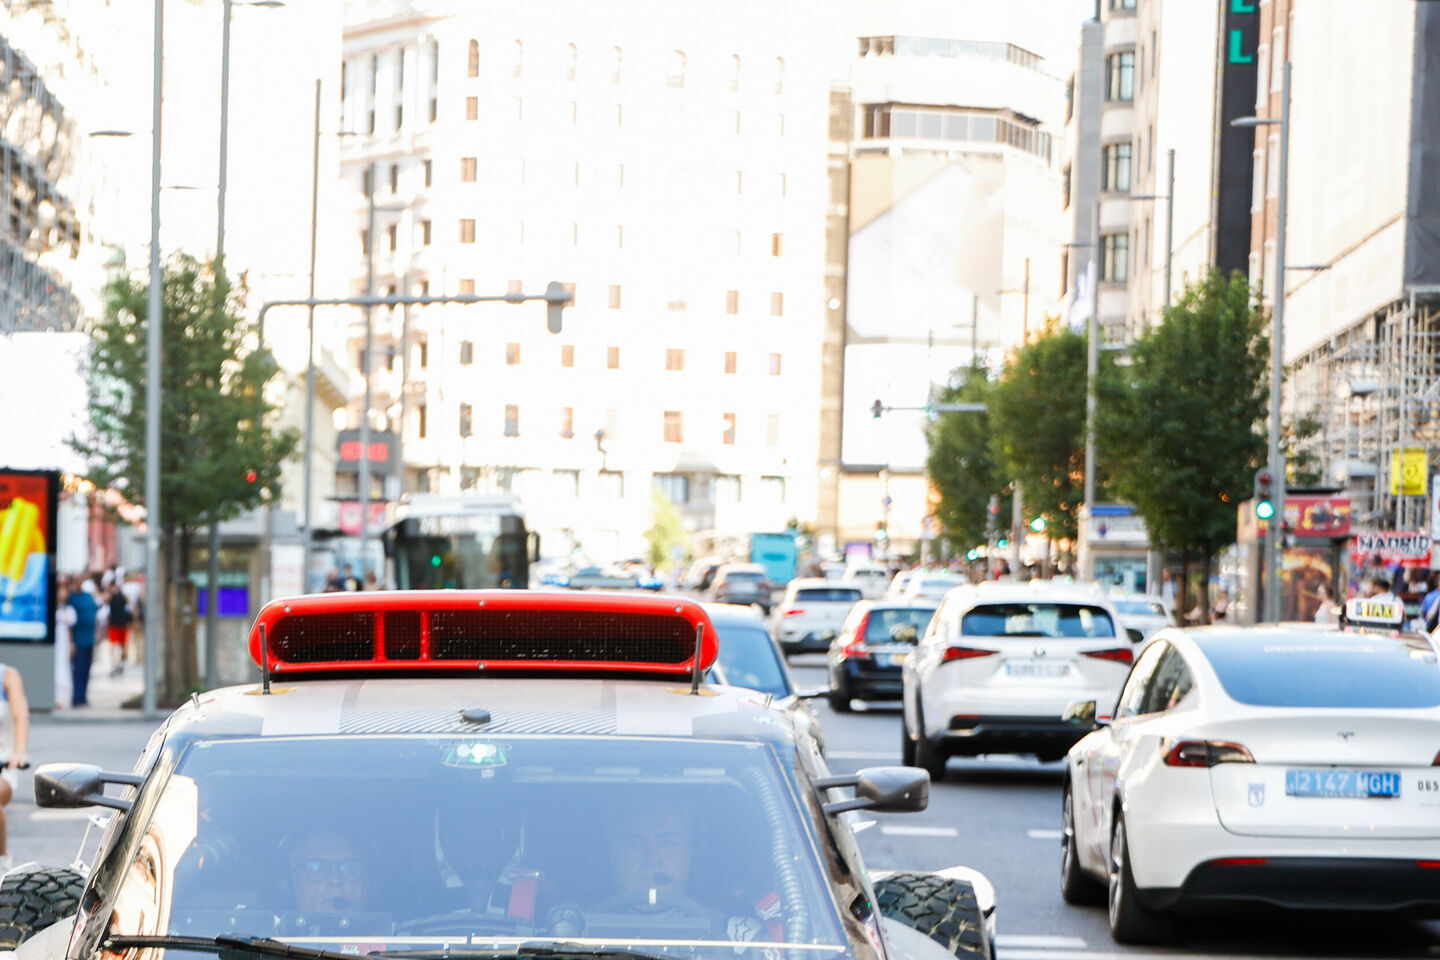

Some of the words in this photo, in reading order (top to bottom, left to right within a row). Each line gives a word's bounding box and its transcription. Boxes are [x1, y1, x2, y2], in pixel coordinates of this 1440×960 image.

[1358, 535, 1430, 550] MADRID
[1300, 773, 1349, 791] 2147
[1356, 774, 1394, 792] MGH
